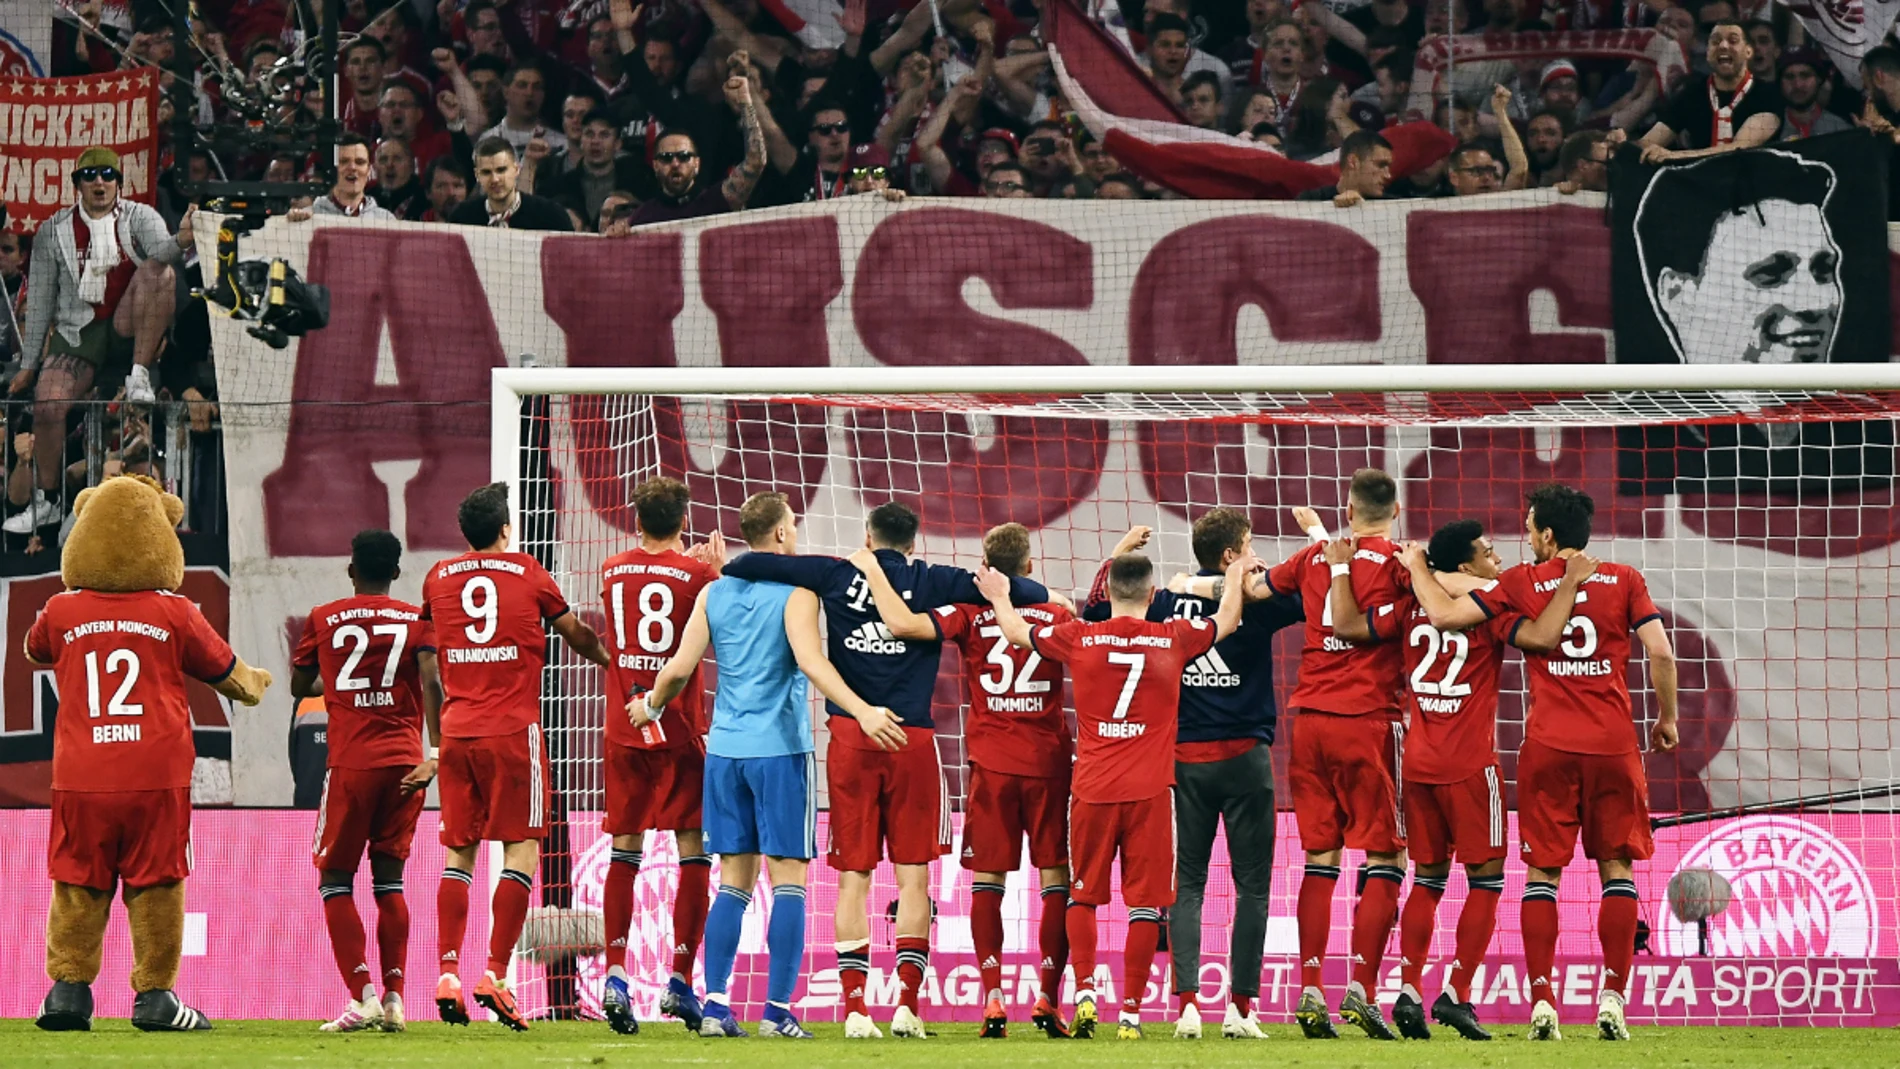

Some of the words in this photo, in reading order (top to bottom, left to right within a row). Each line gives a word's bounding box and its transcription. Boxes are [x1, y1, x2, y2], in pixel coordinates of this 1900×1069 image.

[0, 149, 149, 206] NCN
[261, 202, 1900, 559] AUSGE
[325, 614, 340, 627] FC
[460, 575, 498, 644] 9
[611, 581, 674, 653] 18
[1560, 590, 1598, 658] 5
[63, 630, 75, 645] FC
[74, 620, 114, 639] BAYERN
[446, 646, 518, 664] LEWANDOWSKI
[844, 635, 906, 654] adidas
[1081, 635, 1093, 647] FC
[332, 623, 408, 691] 27
[979, 625, 1050, 694] 32
[1410, 624, 1472, 696] 22
[1547, 659, 1612, 677] HUMMELS
[85, 648, 143, 718] 12
[354, 691, 395, 708] ALABA
[1107, 651, 1146, 719] 7
[1182, 674, 1241, 687] adidas
[986, 696, 1043, 712] KIMMICH
[92, 724, 141, 744] BERNI
[1098, 720, 1146, 738] RIBÉRY
[1723, 833, 1858, 912] BAYERN
[1140, 961, 1294, 1005] SOT
[1711, 964, 1878, 1010] SPORT
